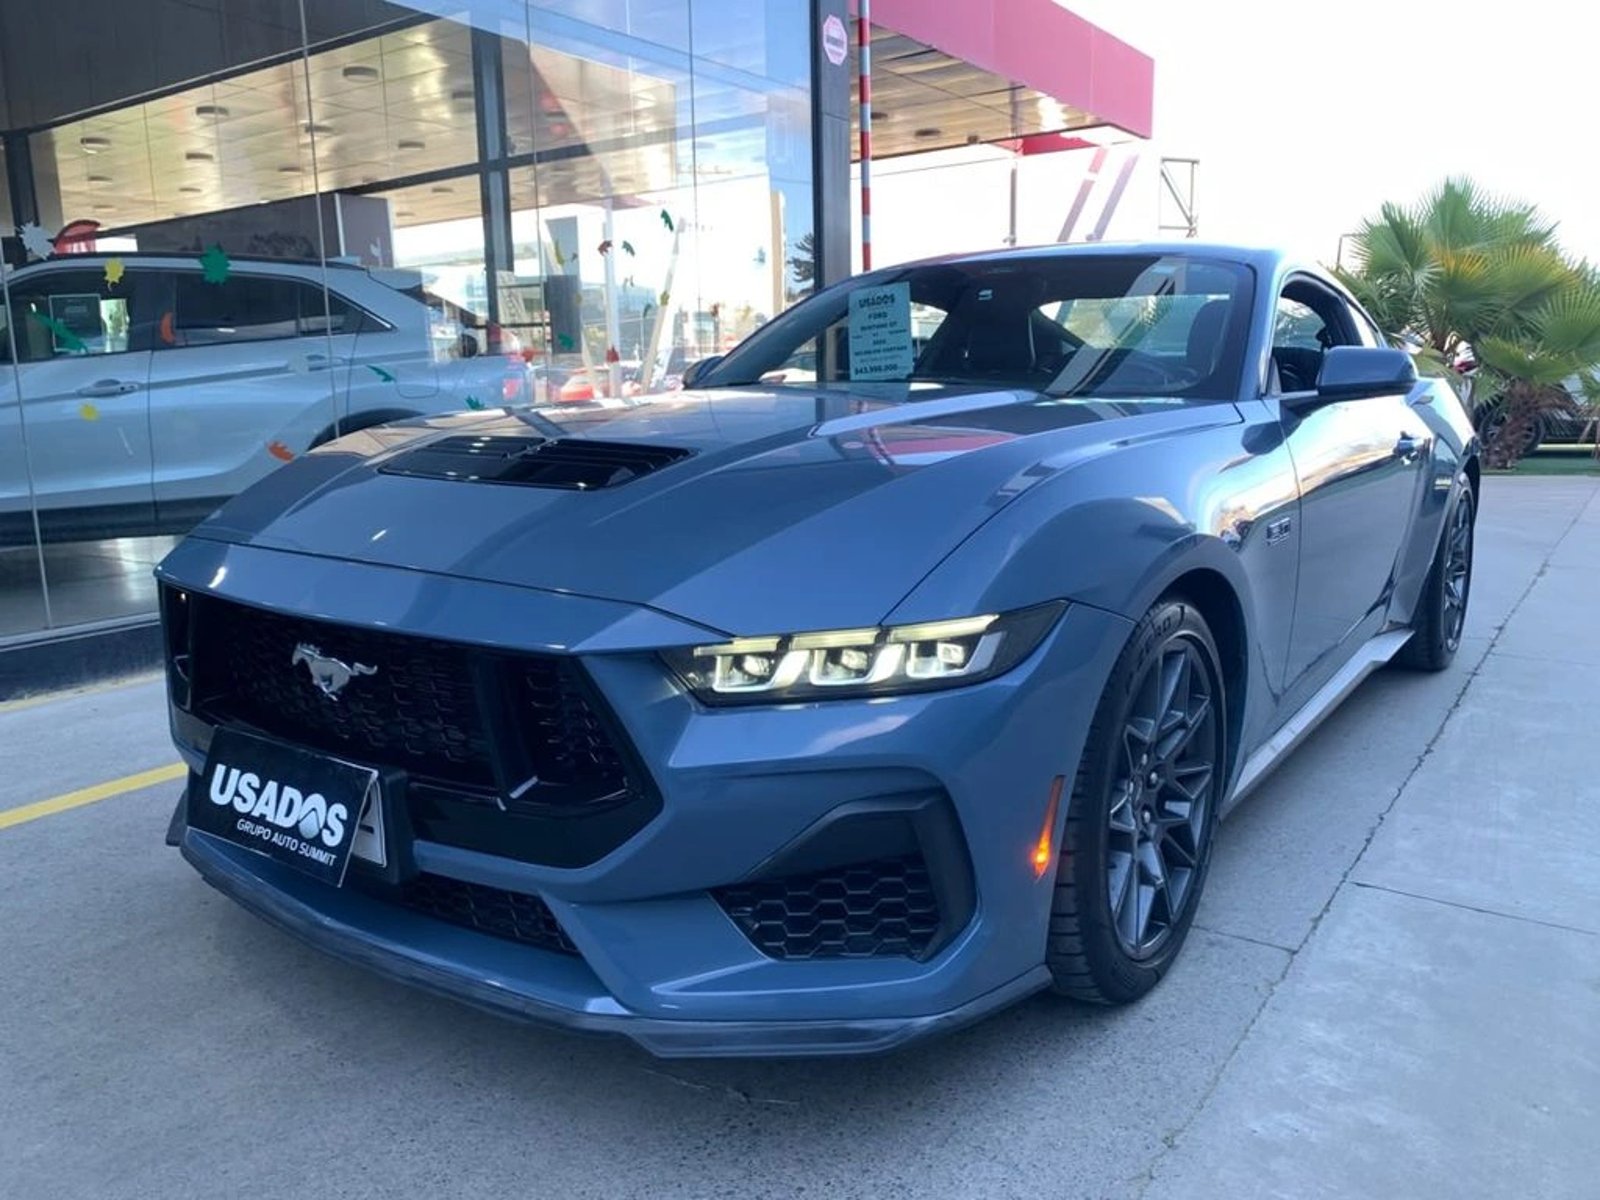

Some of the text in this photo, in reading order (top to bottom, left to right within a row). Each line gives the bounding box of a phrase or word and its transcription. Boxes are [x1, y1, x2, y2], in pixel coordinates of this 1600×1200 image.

[858, 293, 895, 308] USADOS
[209, 763, 348, 848] USADOS
[236, 818, 337, 867] GRUPO AUTO SUMMIT
